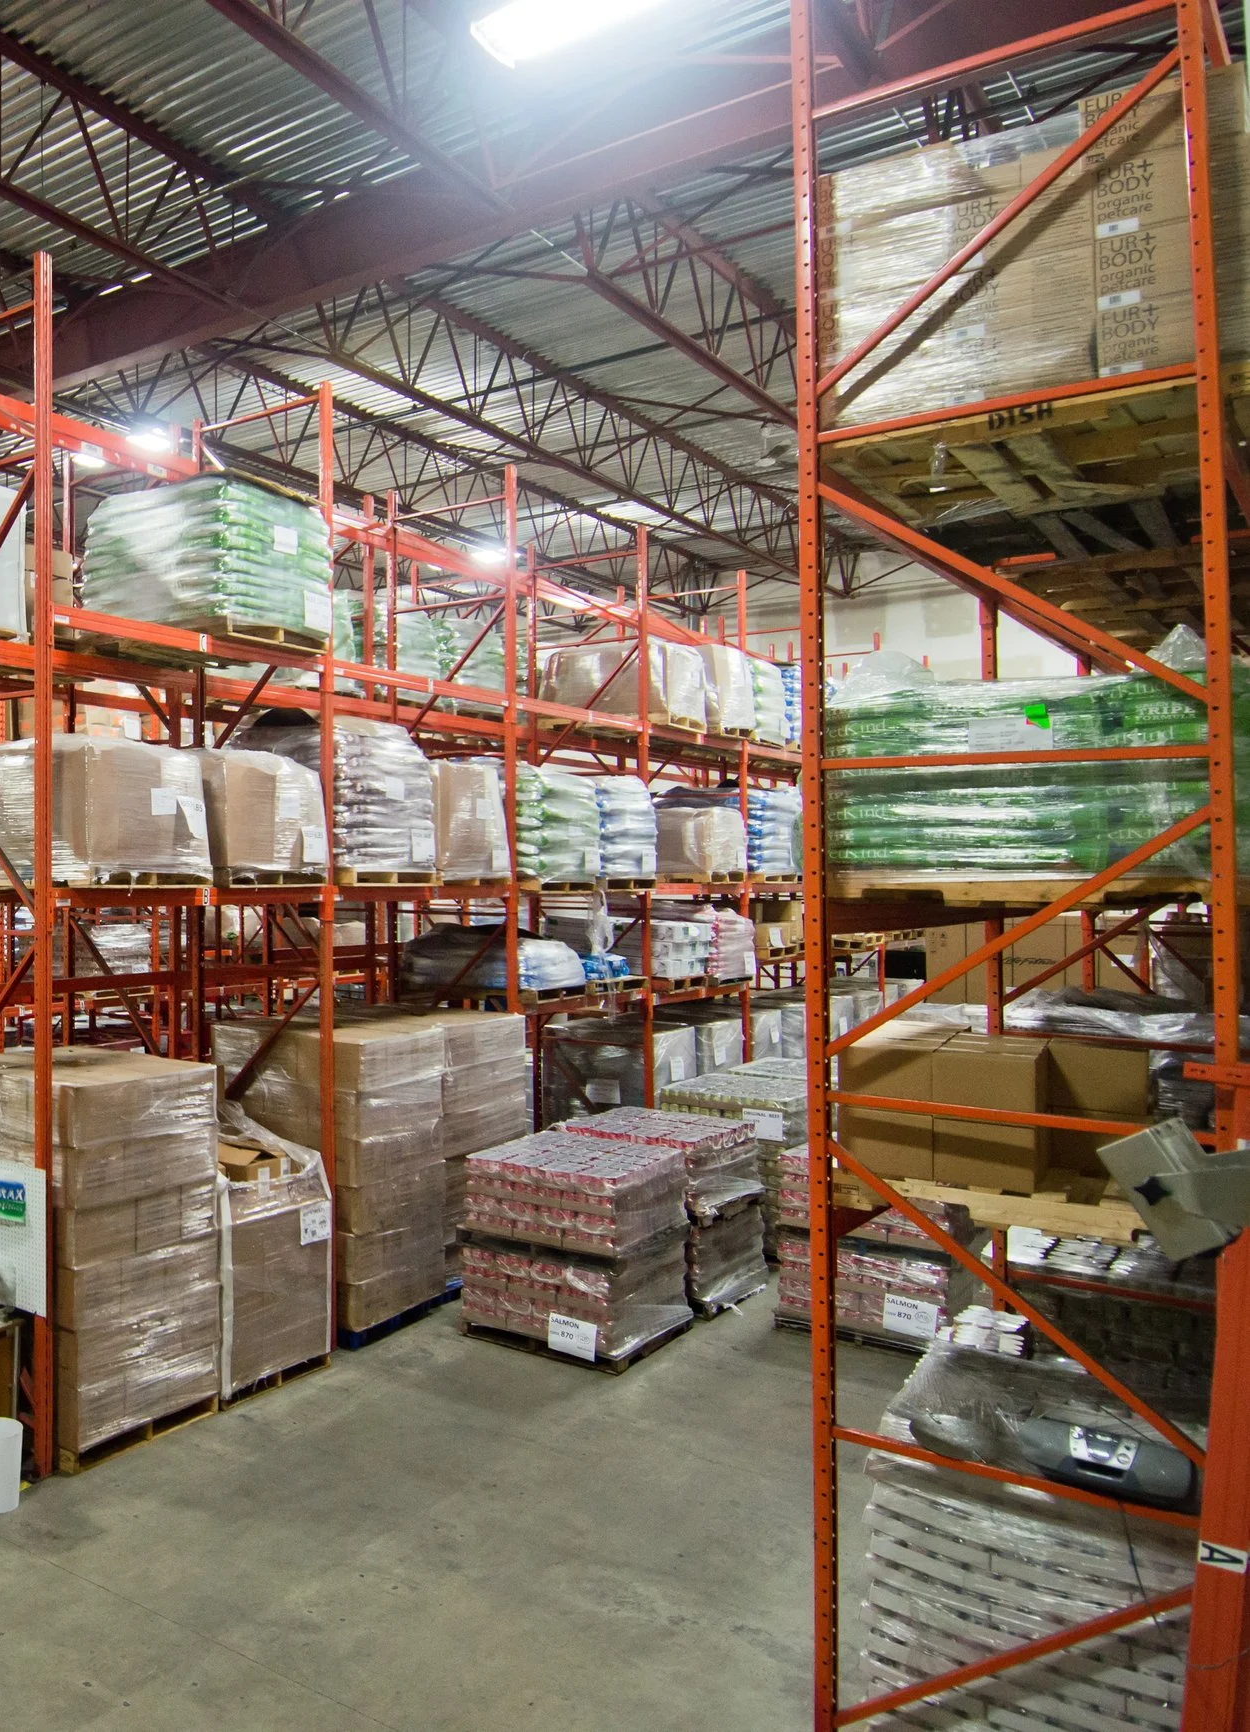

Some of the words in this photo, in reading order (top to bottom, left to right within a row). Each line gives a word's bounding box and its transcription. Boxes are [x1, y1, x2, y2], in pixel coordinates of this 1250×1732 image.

[1097, 172, 1154, 198] BODY
[1097, 190, 1153, 211] organic
[1097, 202, 1154, 225] petcare
[1099, 232, 1157, 256] FUR+
[1100, 244, 1158, 271] BODY
[1100, 263, 1156, 283] organic
[1100, 274, 1157, 296] petcare
[1101, 303, 1161, 326] FUR+
[1102, 315, 1160, 341] BODY
[1102, 334, 1160, 355] organic
[1136, 704, 1197, 716] TRIPE
[203, 888, 209, 905] B
[886, 1296, 919, 1311] SALMON
[551, 1317, 580, 1329] SALMON
[897, 1311, 912, 1321] 870
[560, 1330, 574, 1341] 870
[1200, 1541, 1244, 1565] A
